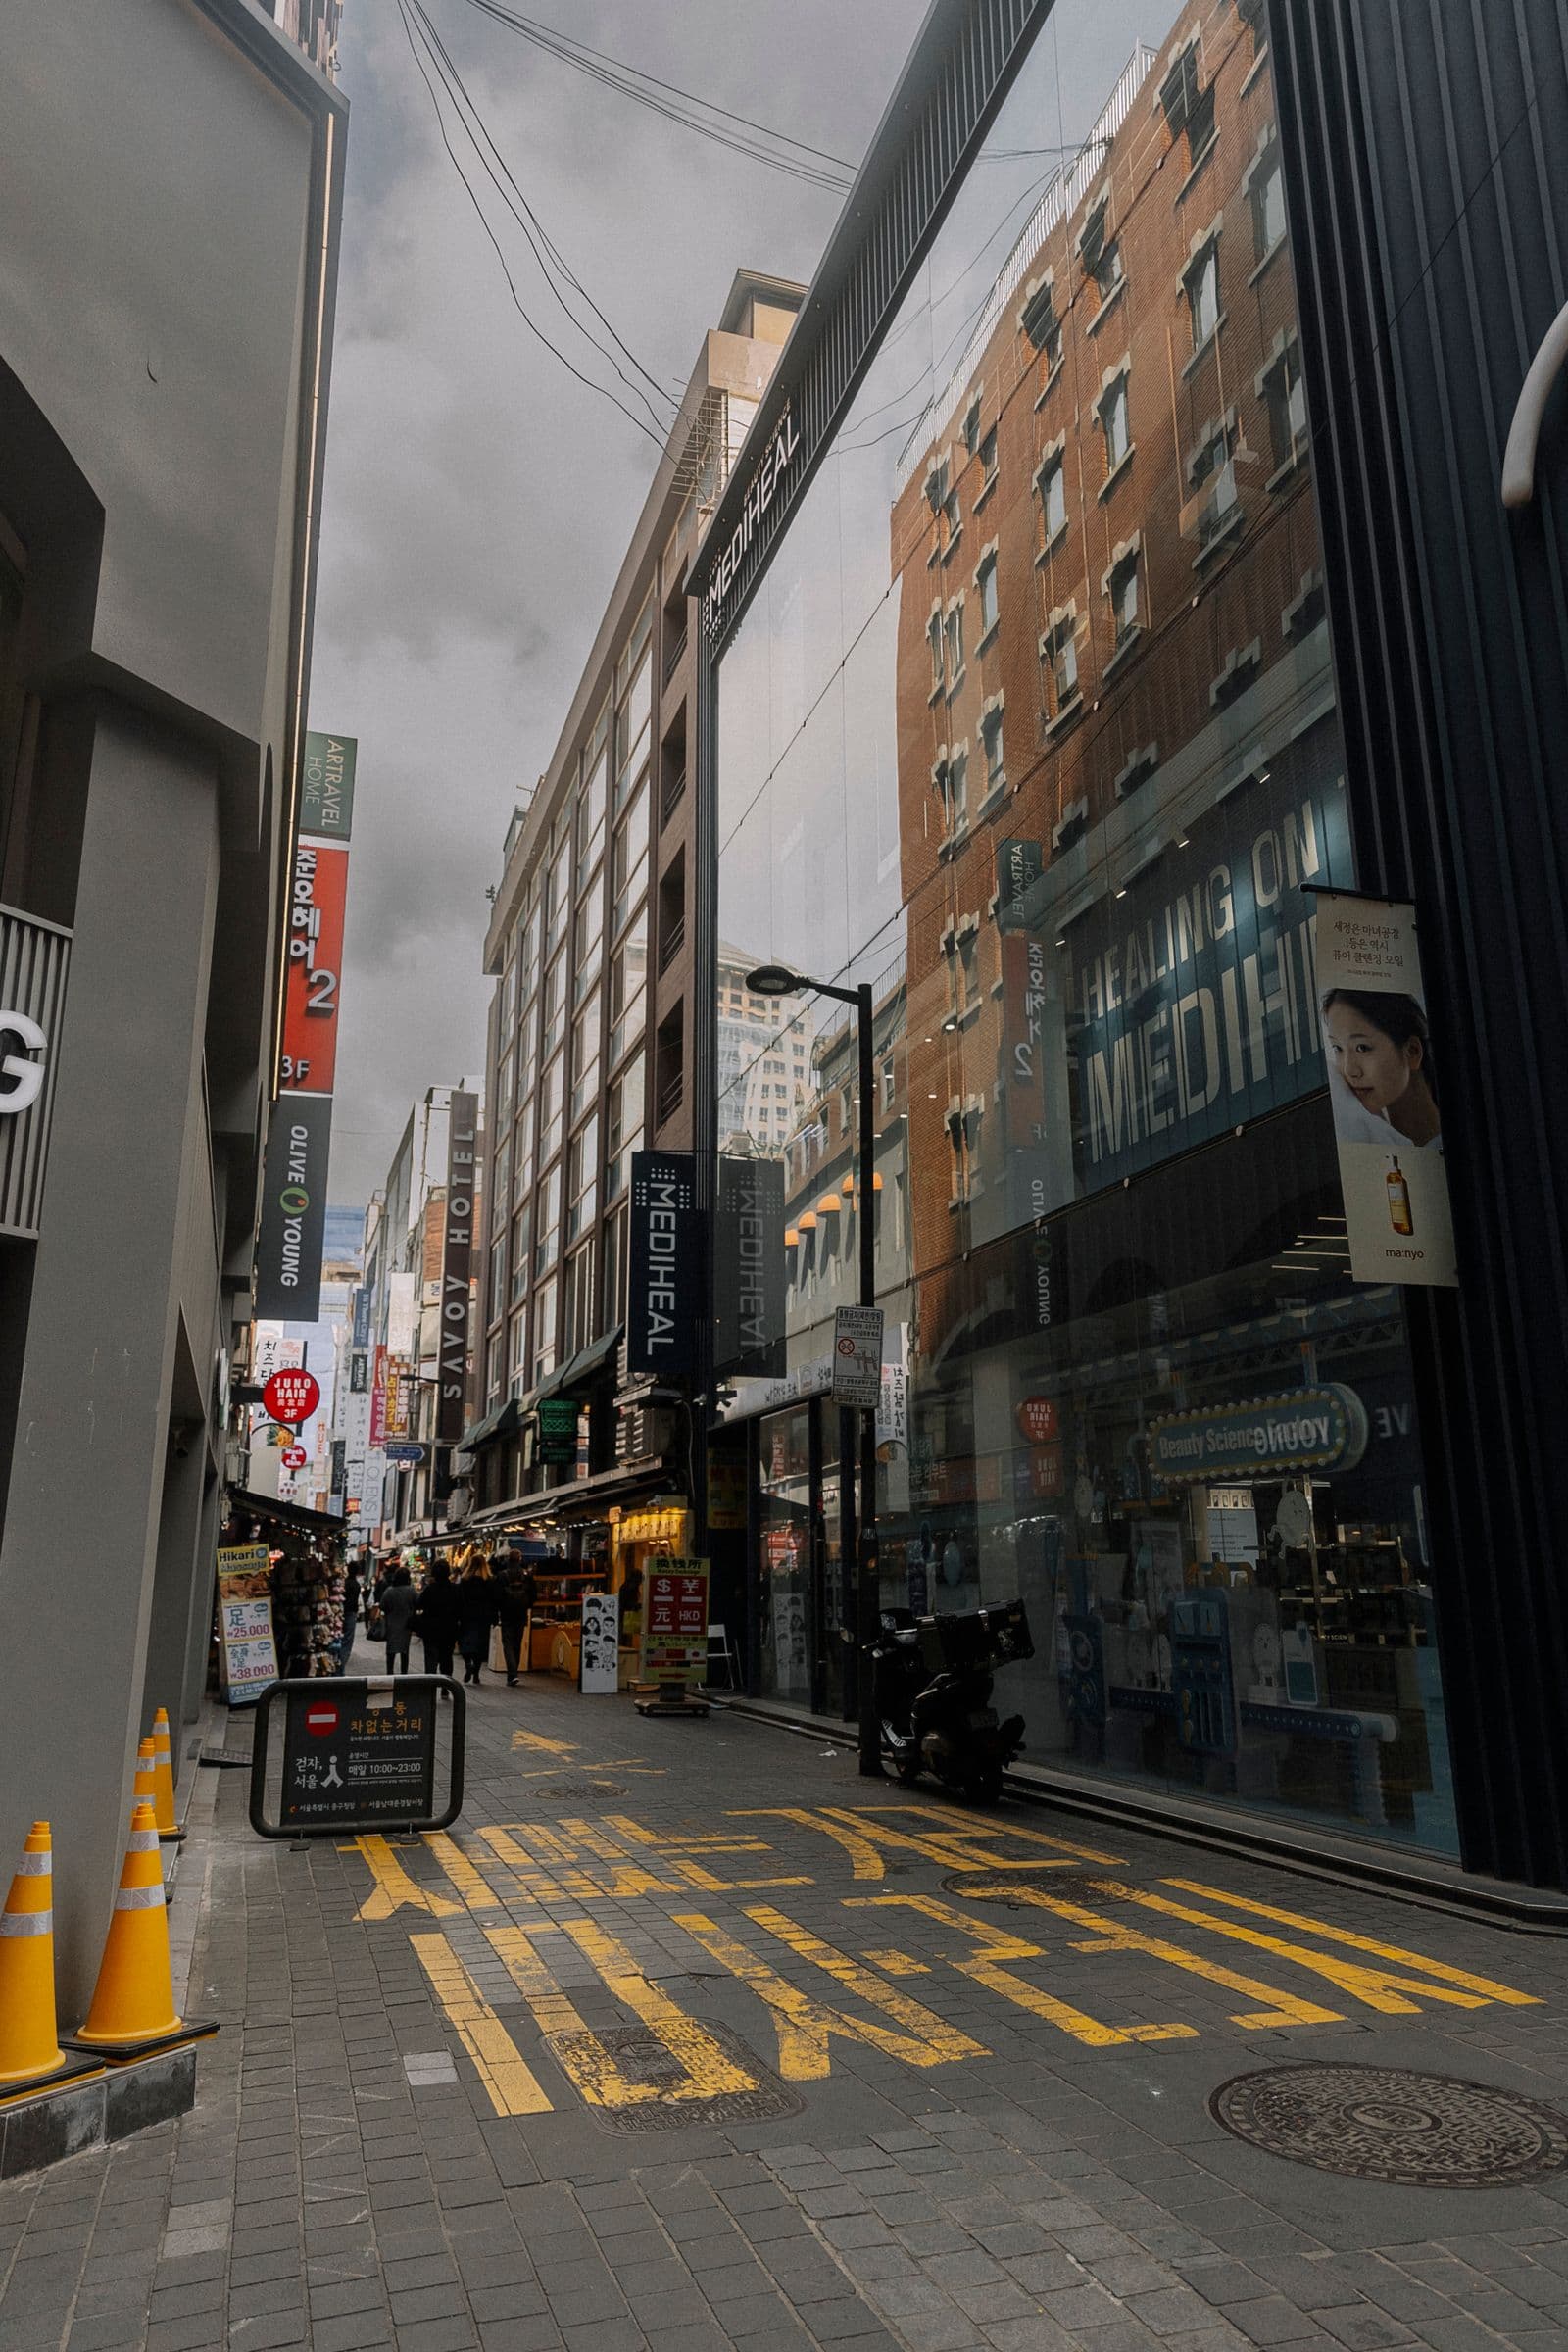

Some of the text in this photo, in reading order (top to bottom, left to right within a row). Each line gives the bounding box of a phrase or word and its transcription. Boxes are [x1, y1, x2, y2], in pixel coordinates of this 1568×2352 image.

[708, 415, 800, 624] MEDIHEAL
[305, 756, 323, 805] HOME
[321, 738, 344, 827] ARTRAVEL
[1082, 799, 1320, 1027] HEALING ON
[307, 969, 337, 1009] 2
[280, 1055, 310, 1079] 3F
[449, 1129, 474, 1245] HOTEL
[280, 1124, 309, 1288] OLIVE YOUNG
[1385, 1246, 1425, 1261] ma:nyo
[647, 1182, 676, 1356] MEDIHEAL
[442, 1274, 469, 1399] SAVOY
[273, 1378, 312, 1389] JUNO
[276, 1388, 307, 1398] HAIR
[283, 1408, 299, 1419] 3F
[1159, 1433, 1206, 1459] Beauty
[218, 1549, 256, 1564] Hikari
[228, 1608, 247, 1627] 足
[655, 1607, 671, 1623] 元
[678, 1610, 700, 1622] HKD
[295, 1755, 323, 1773] 걷자,
[348, 1762, 421, 1777] 매일 10:00~23:00
[294, 1774, 318, 1789] 서울
